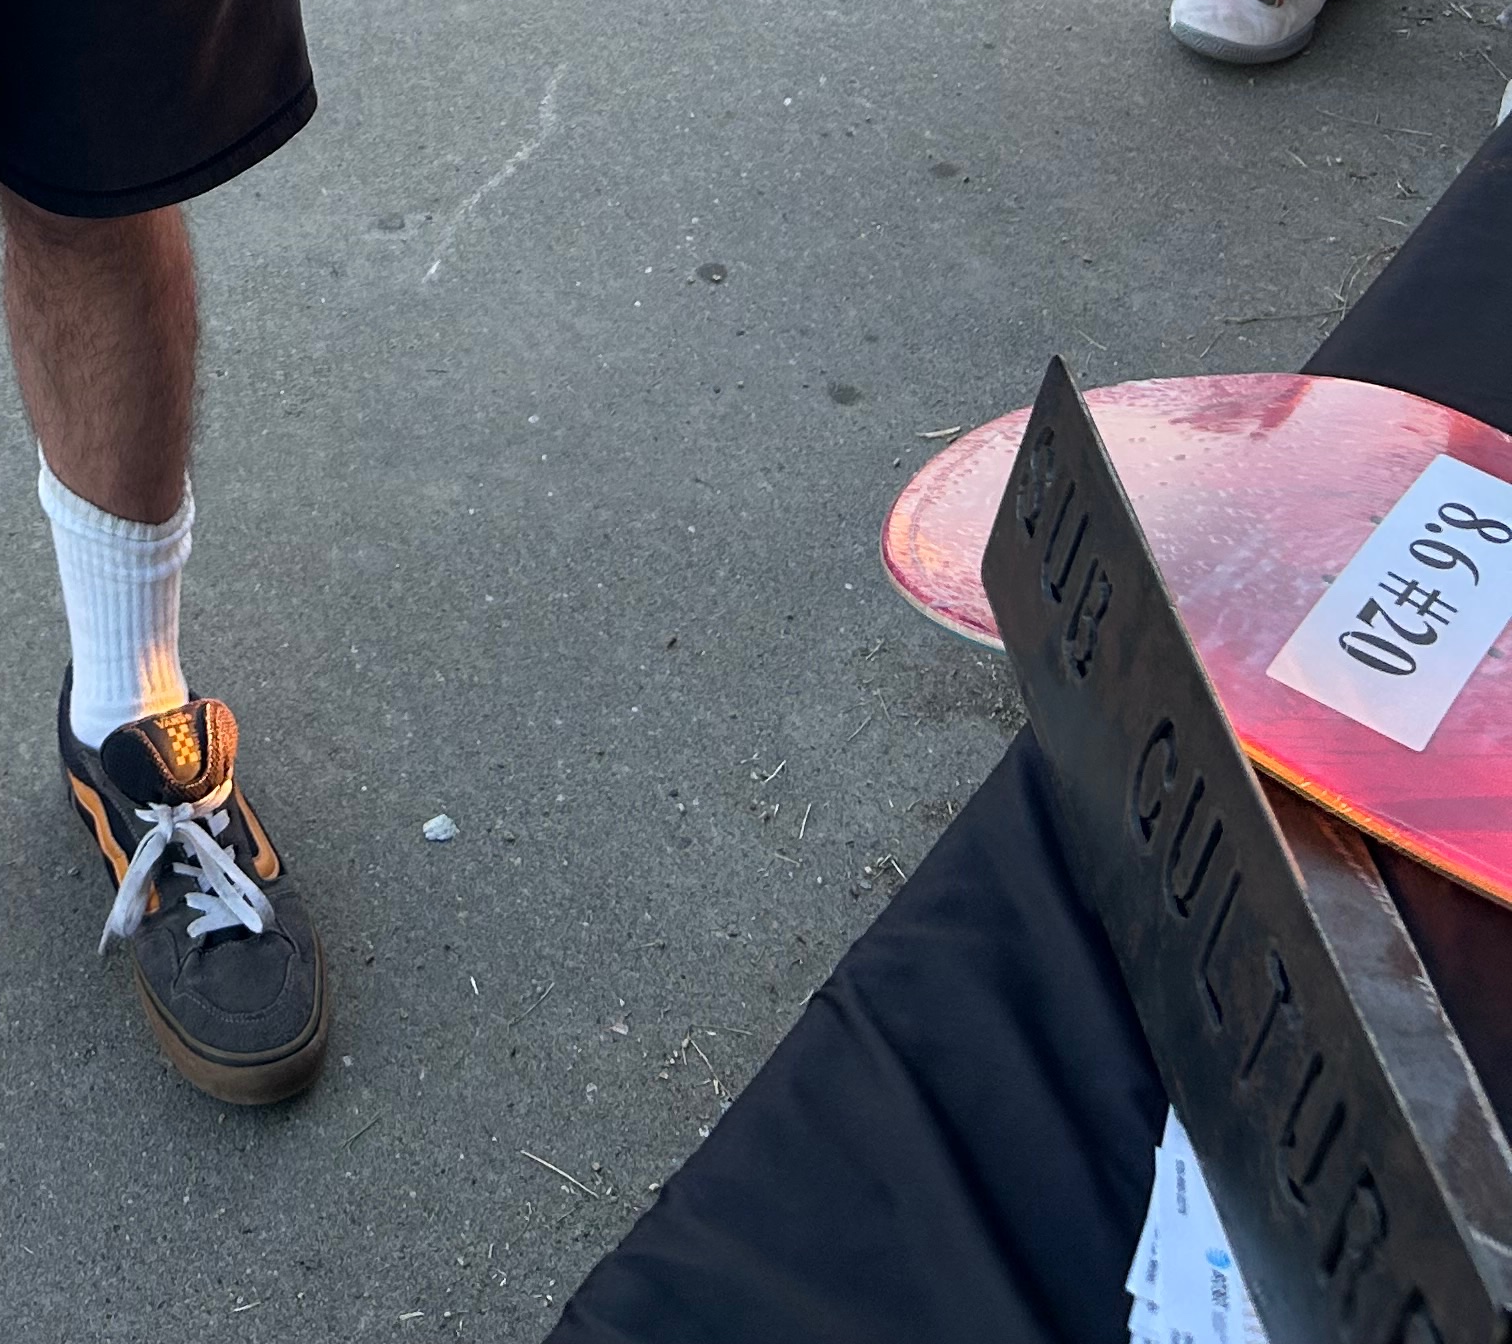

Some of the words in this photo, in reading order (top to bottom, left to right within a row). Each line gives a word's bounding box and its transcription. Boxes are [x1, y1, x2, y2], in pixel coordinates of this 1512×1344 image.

[1014, 424, 1113, 680] SUB
[1409, 502, 1512, 587] 8.6
[1338, 571, 1458, 676] #20
